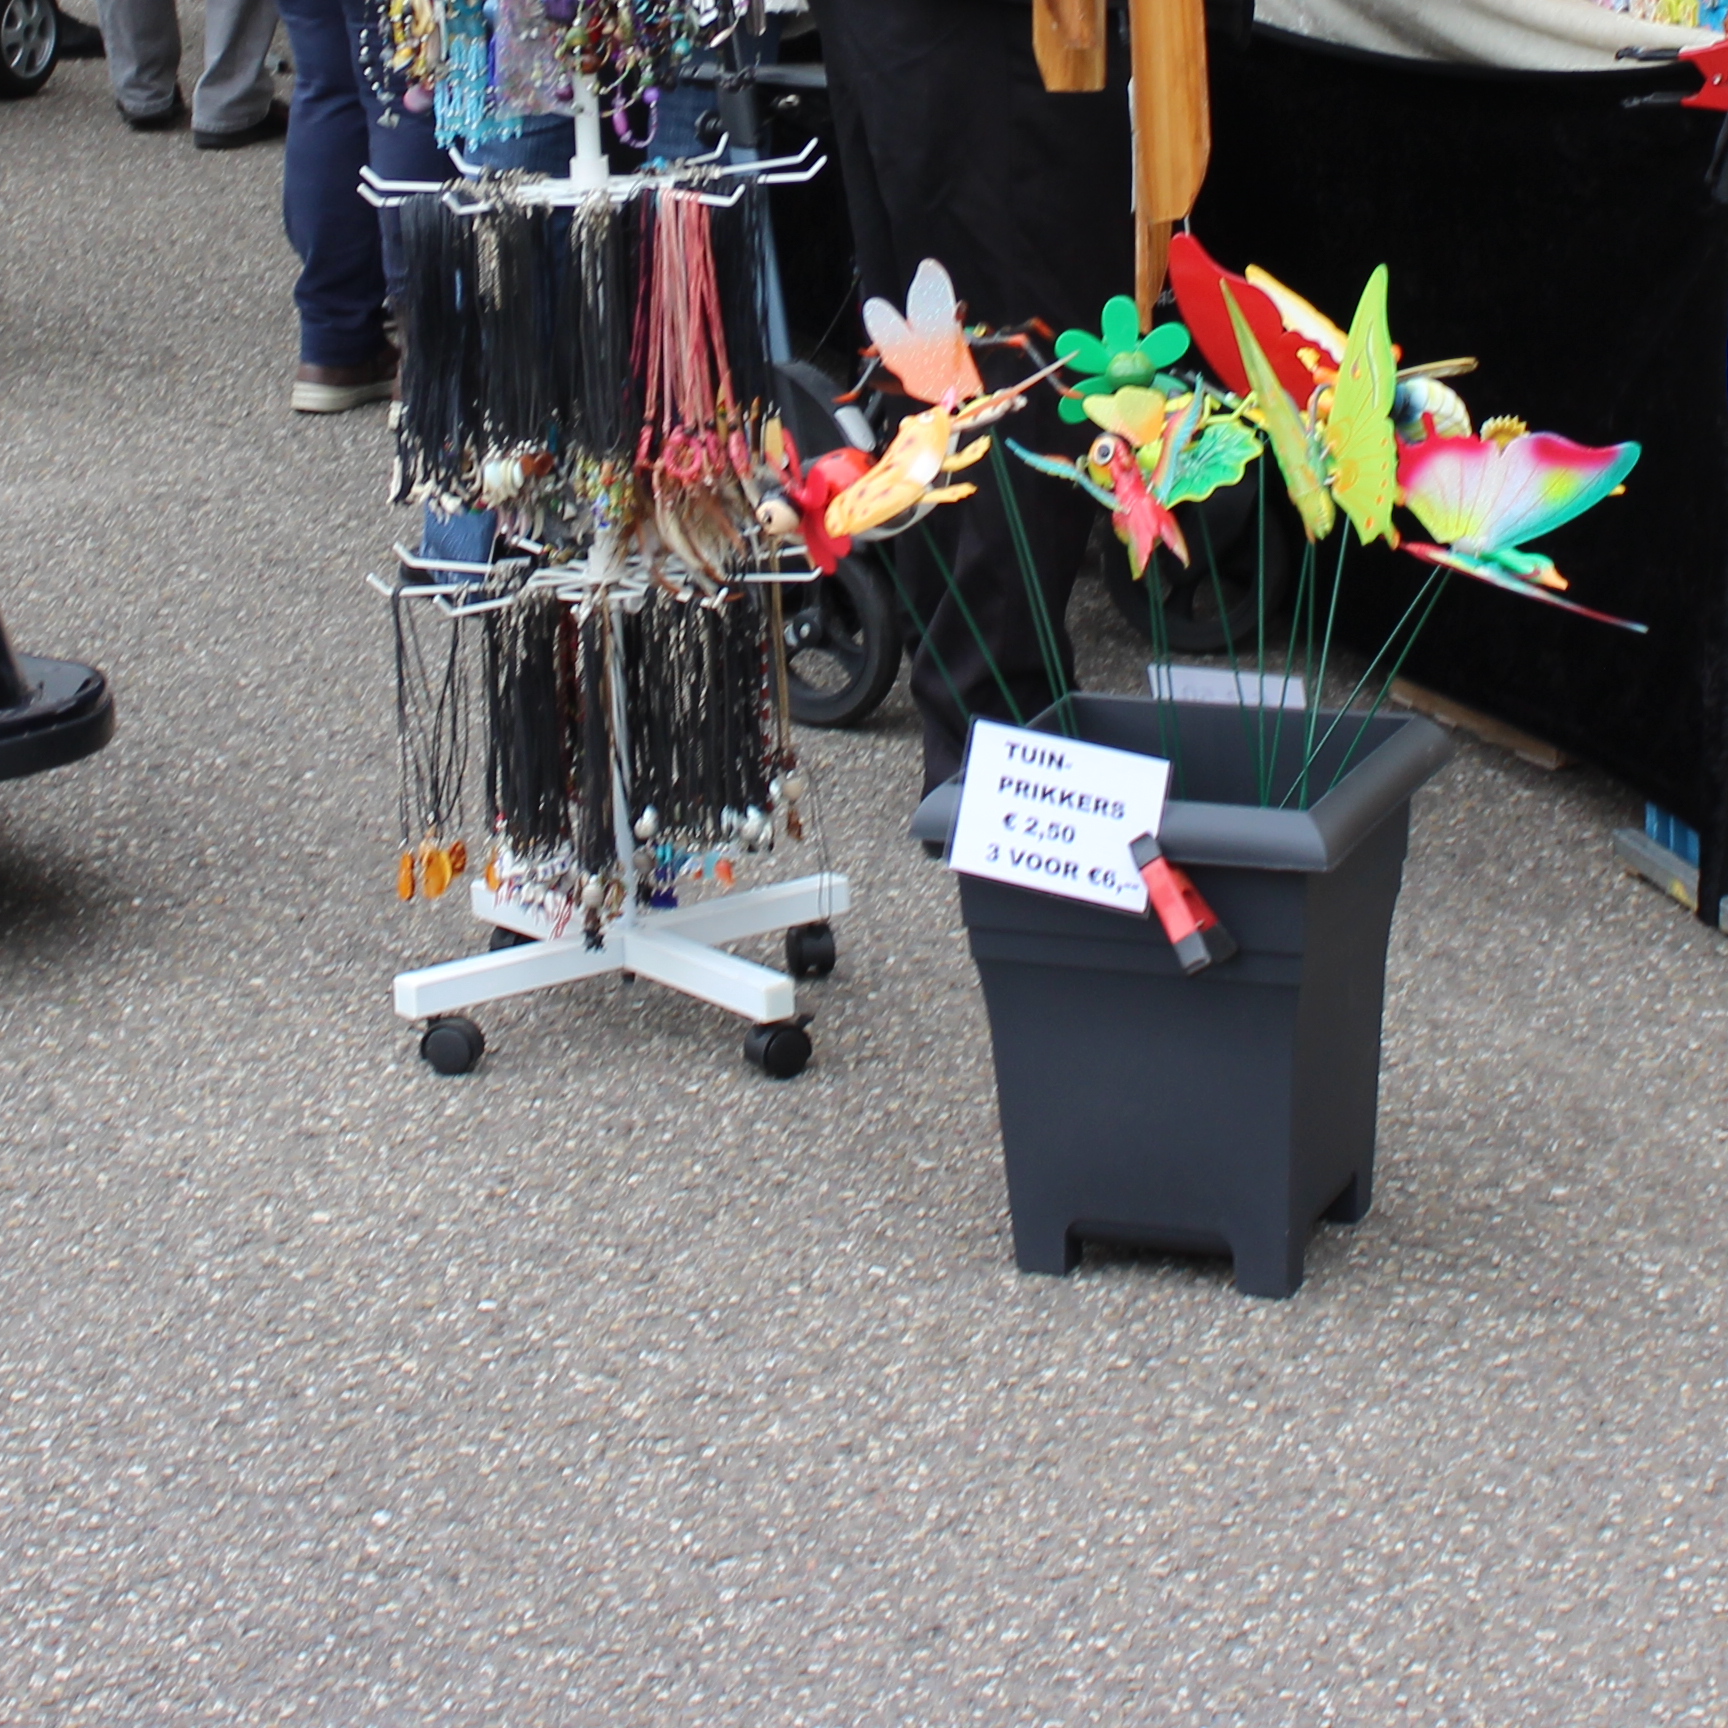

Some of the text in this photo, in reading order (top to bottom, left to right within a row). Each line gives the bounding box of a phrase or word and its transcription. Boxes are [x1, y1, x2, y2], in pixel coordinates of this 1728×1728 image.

[1005, 741, 1073, 770] TUIN-
[998, 775, 1125, 820] PRIKKERS
[1003, 812, 1076, 844] € 2,50
[986, 843, 1000, 862] 3
[1010, 848, 1078, 880] VOOR
